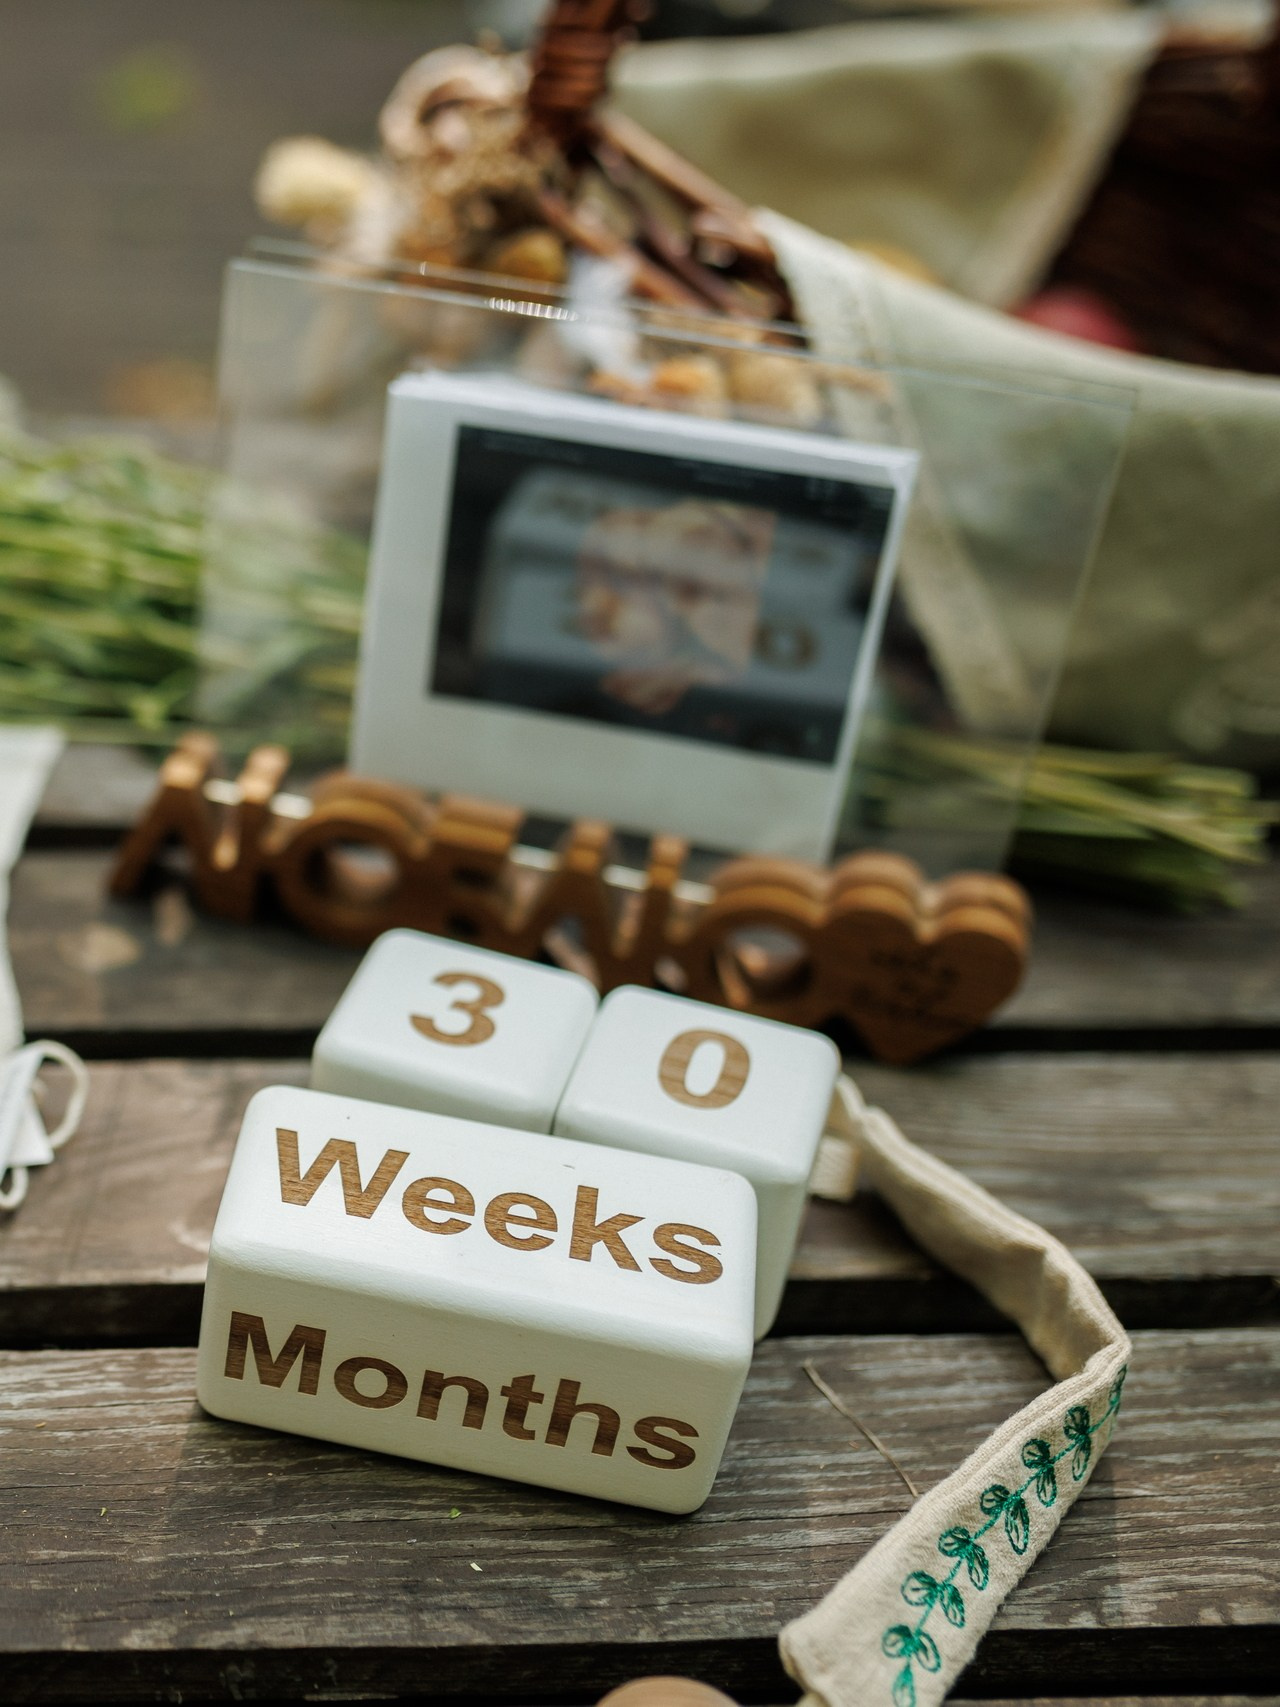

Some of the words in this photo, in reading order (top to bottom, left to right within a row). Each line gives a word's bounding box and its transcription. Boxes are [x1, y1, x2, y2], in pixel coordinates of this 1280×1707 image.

[409, 970, 506, 1048] 3
[274, 1126, 725, 1285] Weeks
[222, 1309, 701, 1470] Months
